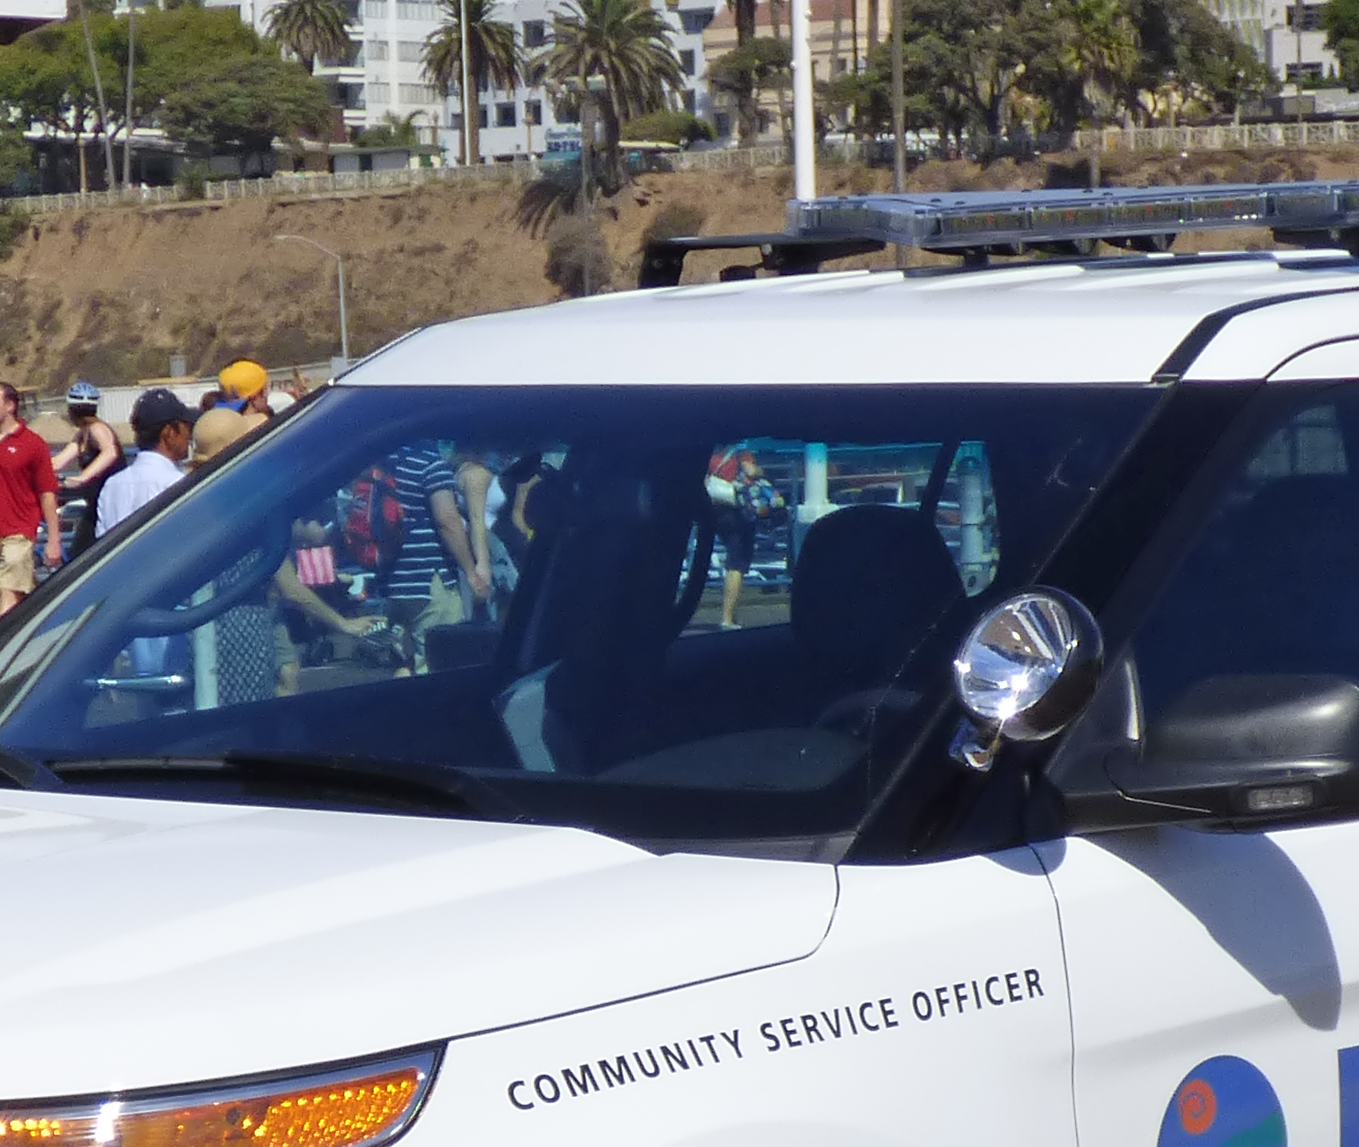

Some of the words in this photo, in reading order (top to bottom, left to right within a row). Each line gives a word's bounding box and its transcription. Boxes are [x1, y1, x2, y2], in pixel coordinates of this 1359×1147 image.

[507, 1029, 745, 1111] COMMUNITY
[760, 997, 899, 1052] SERVICE
[911, 968, 1045, 1021] OFFICER
